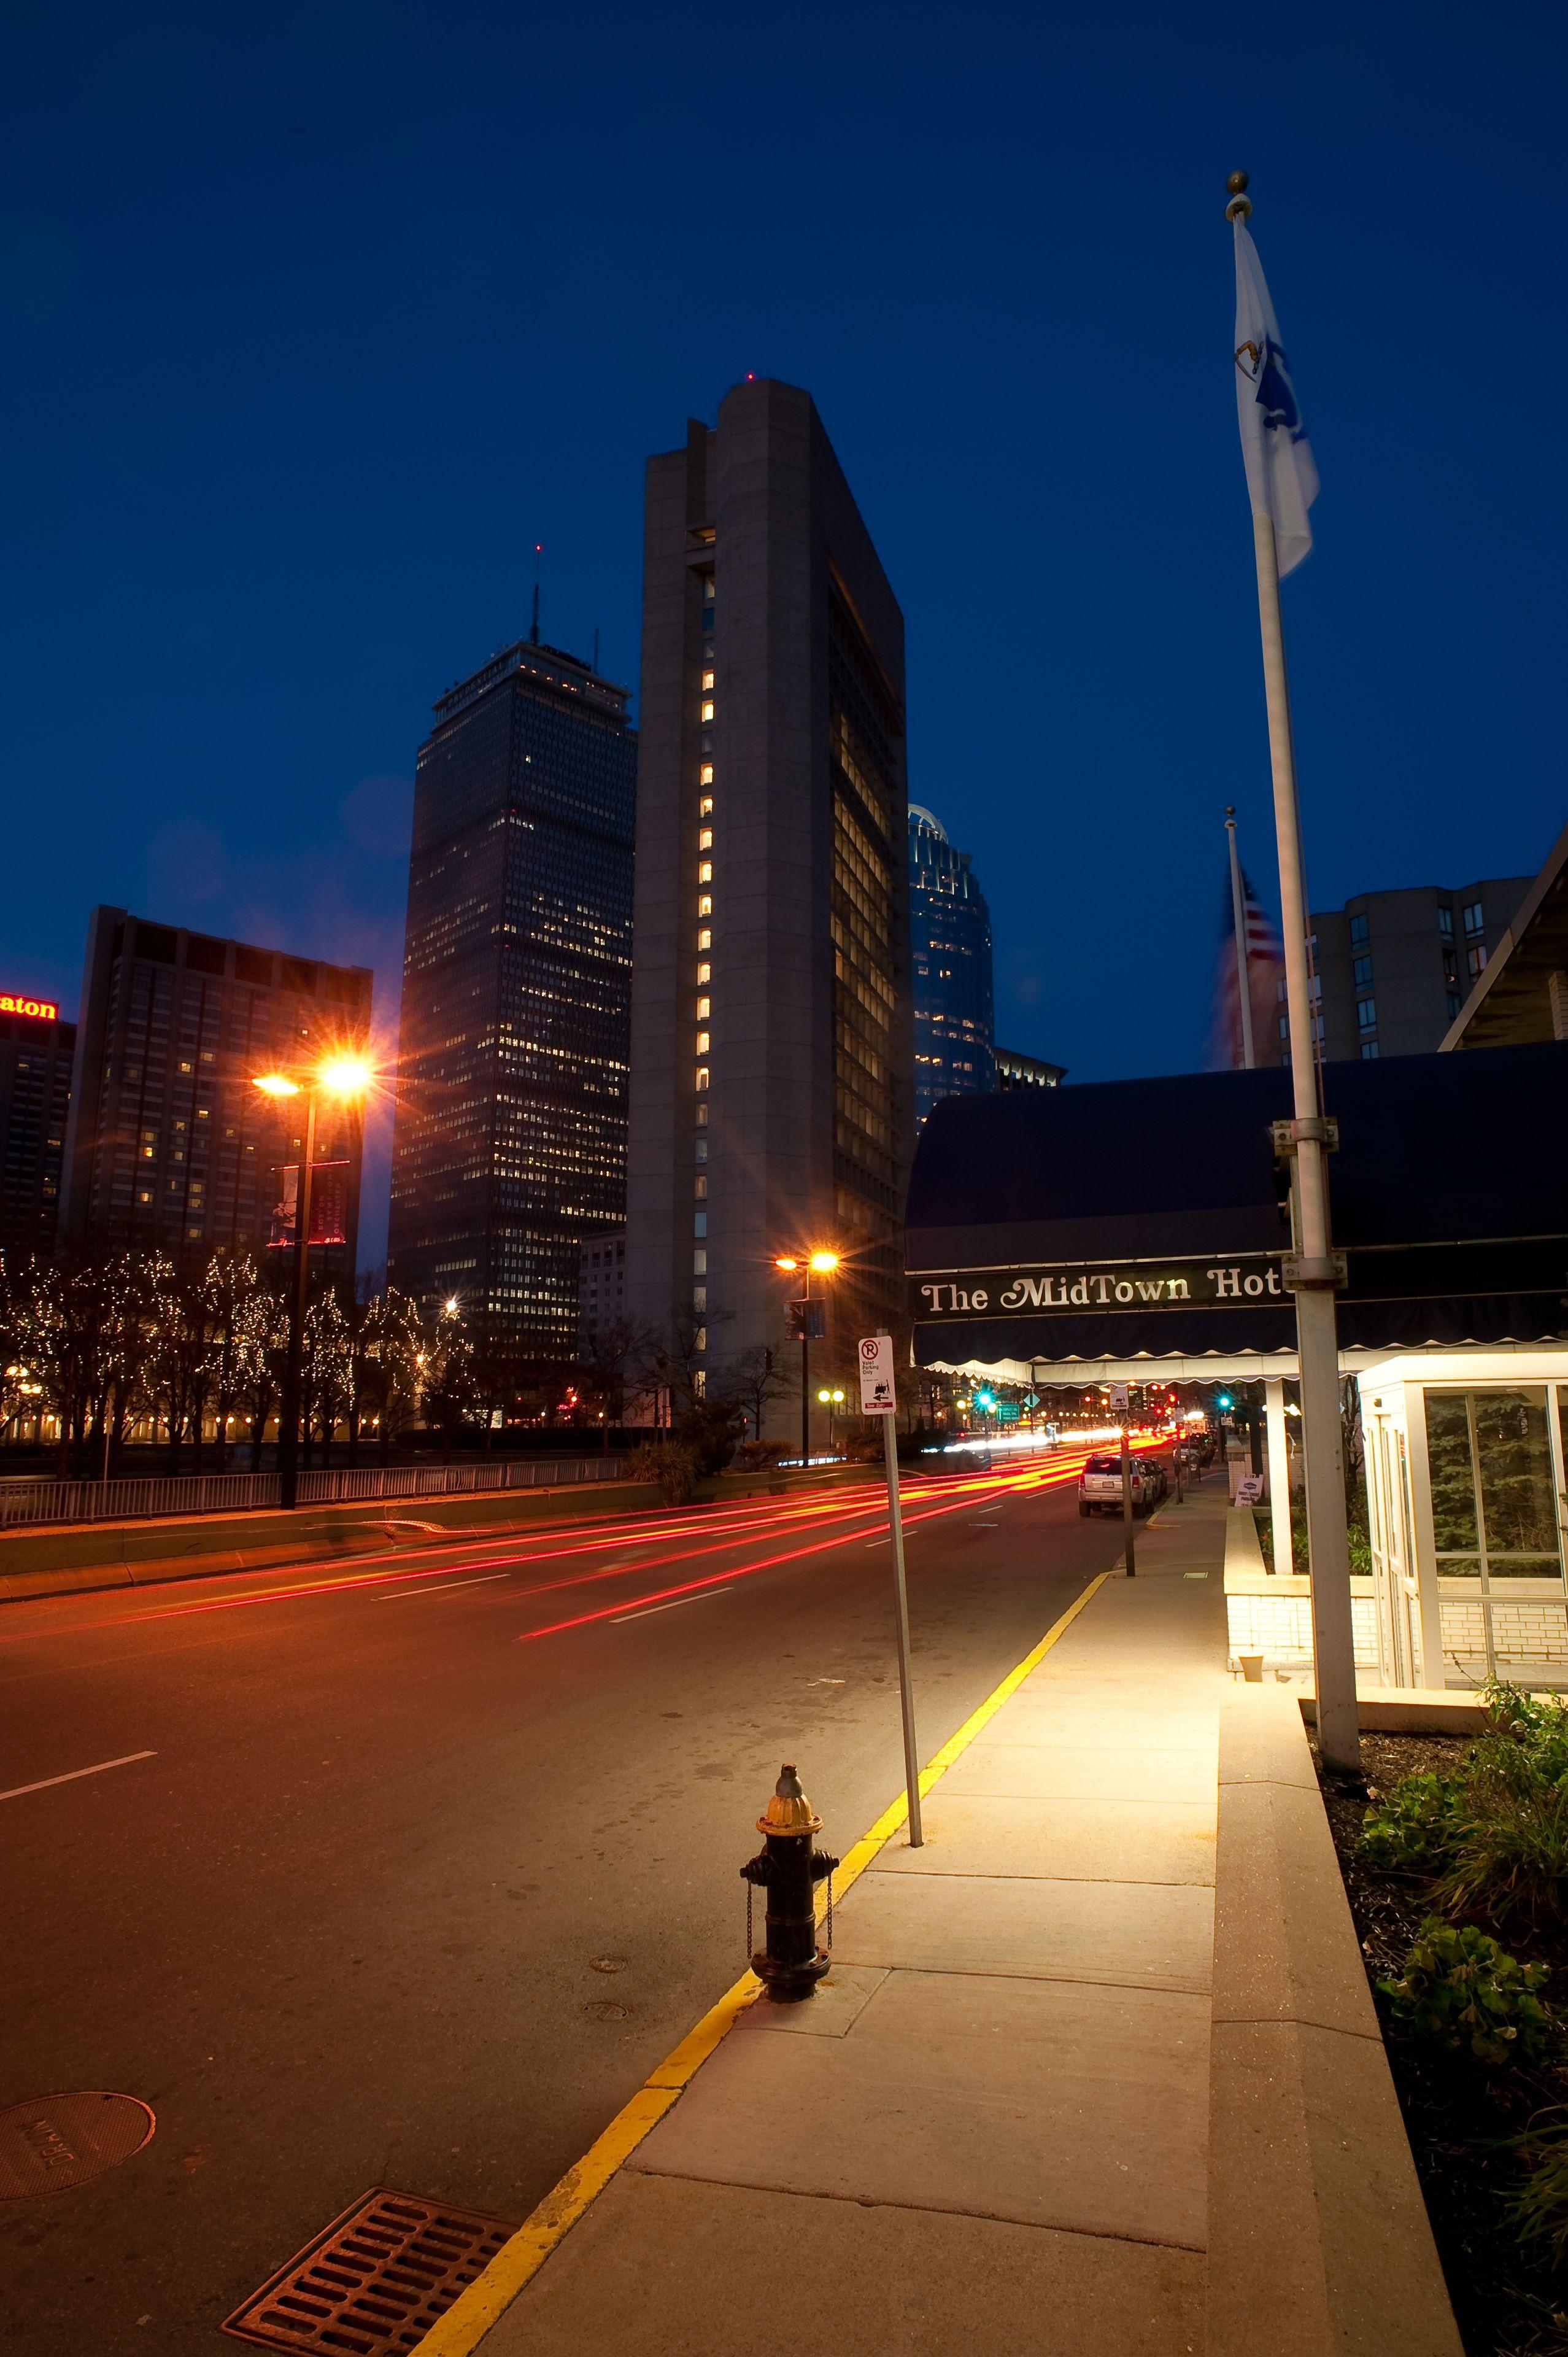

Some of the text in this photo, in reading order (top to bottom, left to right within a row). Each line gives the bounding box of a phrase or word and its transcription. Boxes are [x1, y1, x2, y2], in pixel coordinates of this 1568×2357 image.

[921, 1267, 1296, 1312] The MidTown Hot
